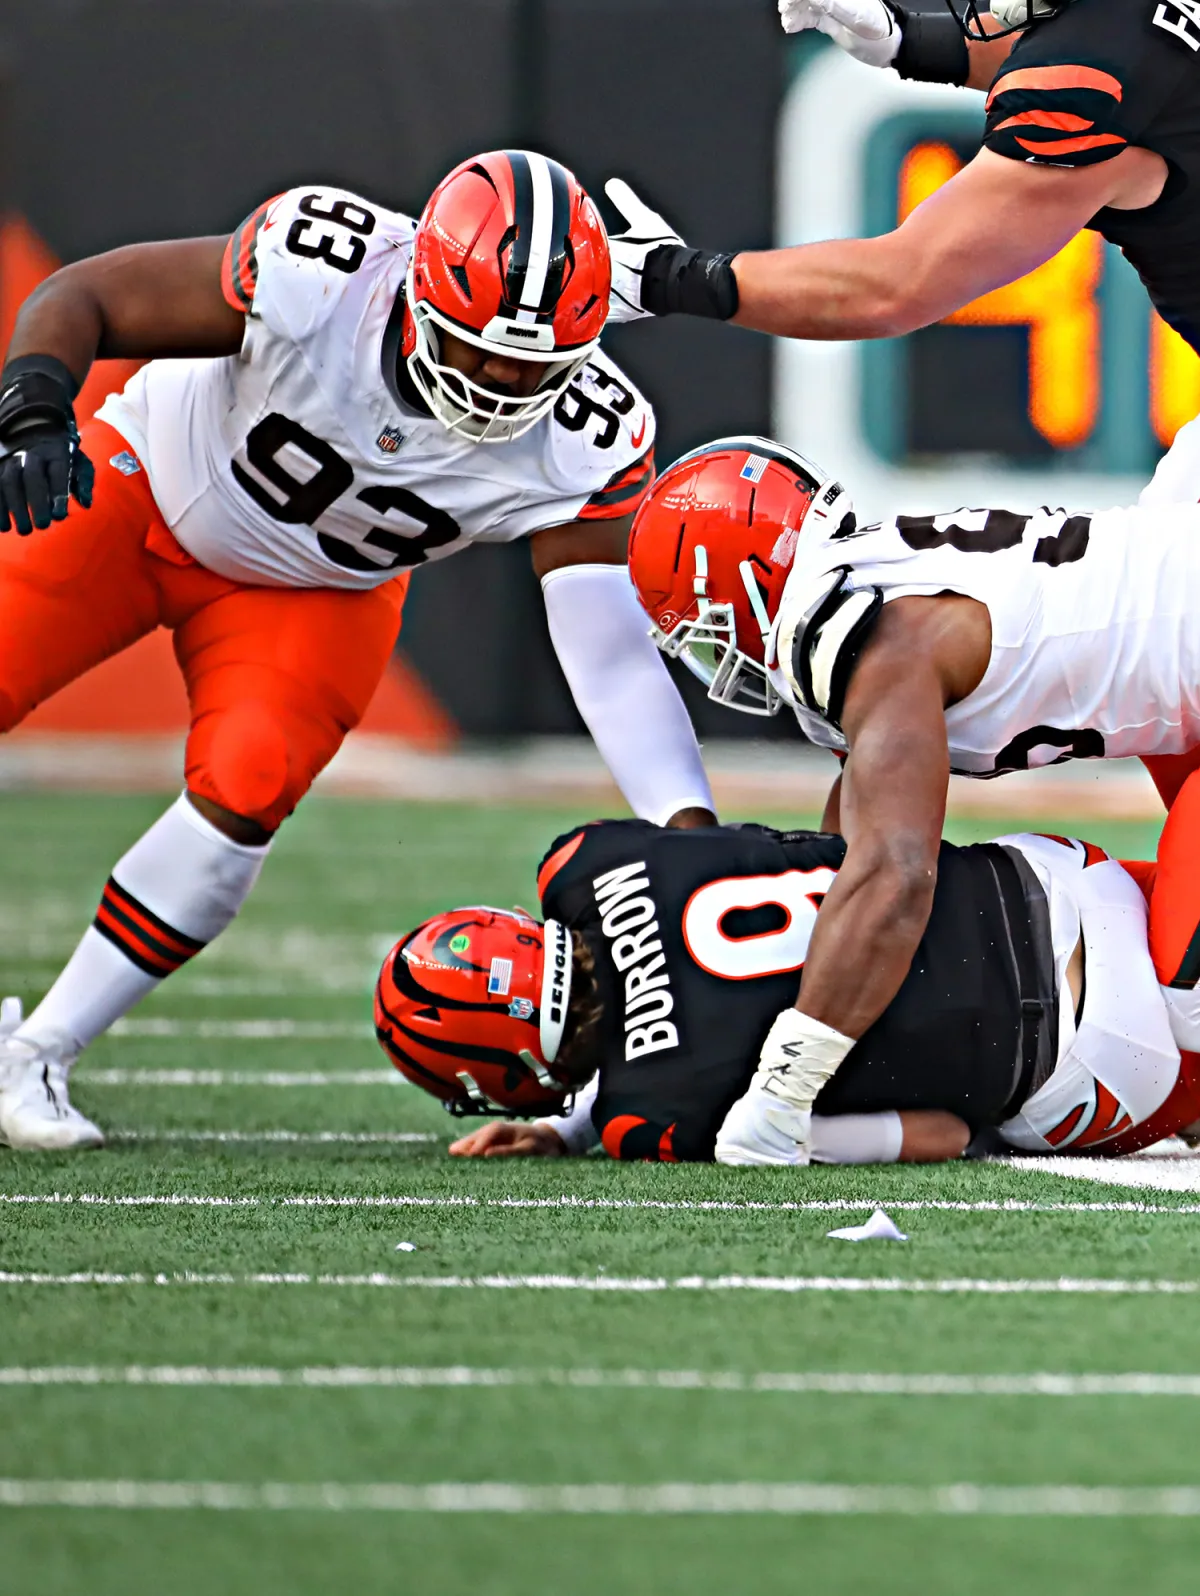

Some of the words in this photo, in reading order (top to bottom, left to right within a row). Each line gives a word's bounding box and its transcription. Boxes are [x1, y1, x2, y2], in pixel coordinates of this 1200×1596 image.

[284, 193, 376, 274] 93
[553, 361, 635, 450] 93
[230, 412, 461, 571] 93
[593, 860, 680, 1062] BURROW
[681, 866, 839, 981] 9
